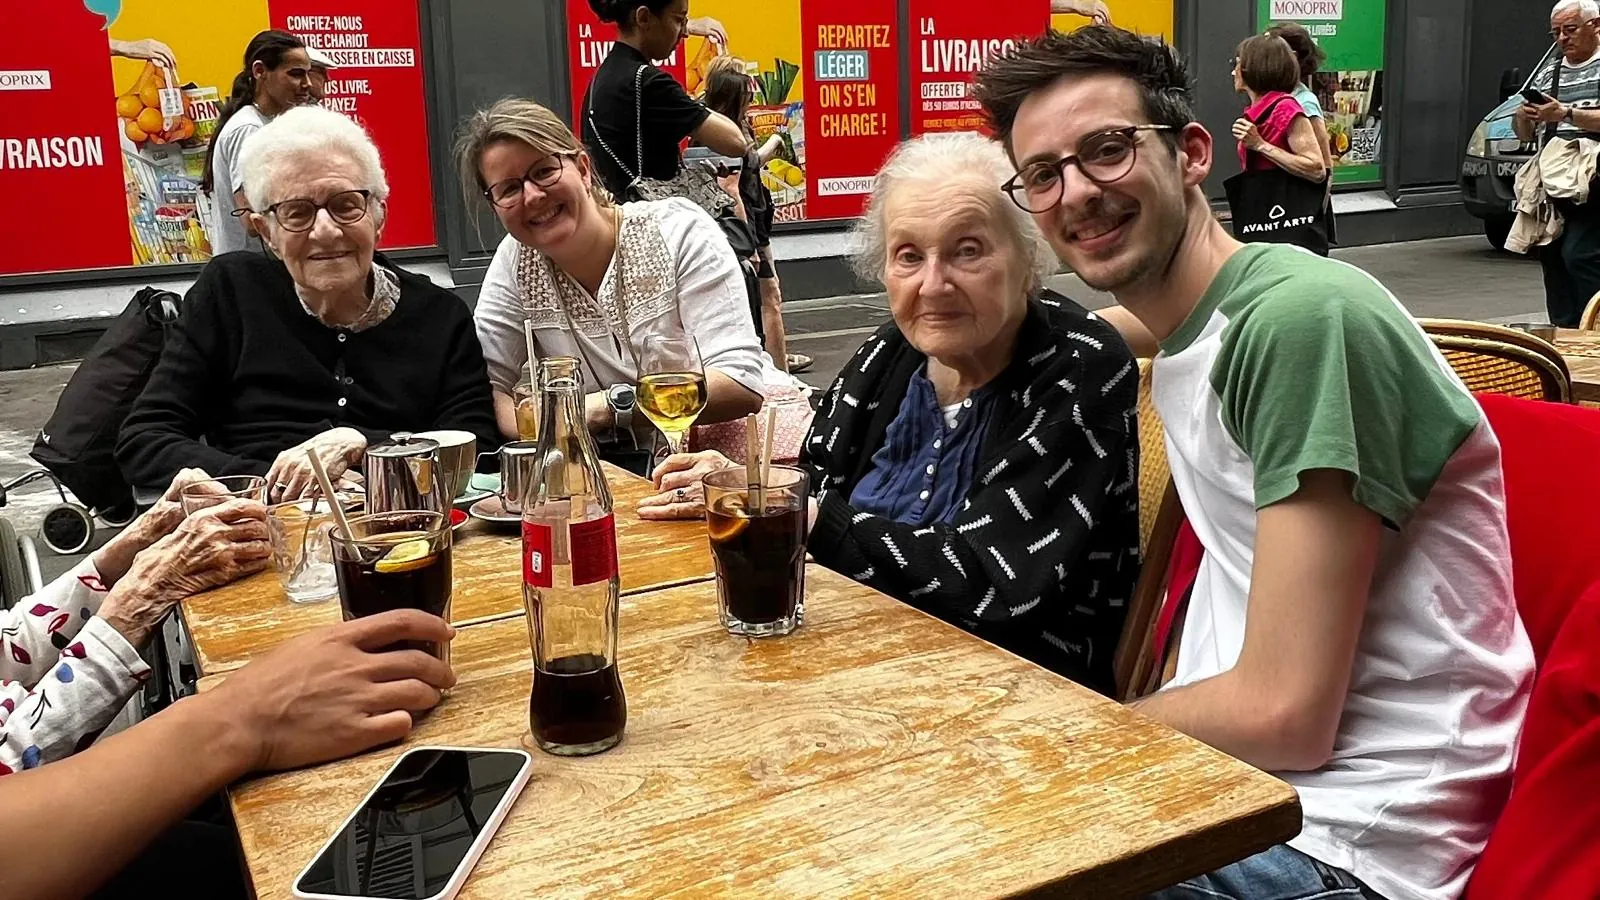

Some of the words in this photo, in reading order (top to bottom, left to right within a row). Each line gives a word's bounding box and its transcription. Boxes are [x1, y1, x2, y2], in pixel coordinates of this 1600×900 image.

[1274, 1, 1338, 15] MONOPRIX
[286, 15, 363, 31] CONFIEZ-NOUS
[578, 23, 592, 38] LA
[920, 17, 935, 35] LA
[292, 33, 324, 48] OTRE
[323, 33, 369, 48] CHARIOT
[817, 24, 891, 49] REPARTEZ
[321, 51, 361, 65] ASSER
[362, 51, 375, 65] EN
[377, 51, 412, 65] CAISSE
[920, 38, 1024, 73] LIVRAISO
[818, 50, 865, 78] LÉGER
[0, 74, 45, 87] OPRIX
[324, 79, 339, 94] US
[340, 79, 372, 95] LIVRE,
[819, 84, 841, 108] ON
[843, 83, 876, 107] S'EN
[324, 97, 357, 112] PAYEZ
[820, 113, 879, 138] CHARGE
[822, 180, 876, 192] MONOPRI
[1242, 220, 1280, 234] AVANT
[1283, 215, 1315, 229] ARTE
